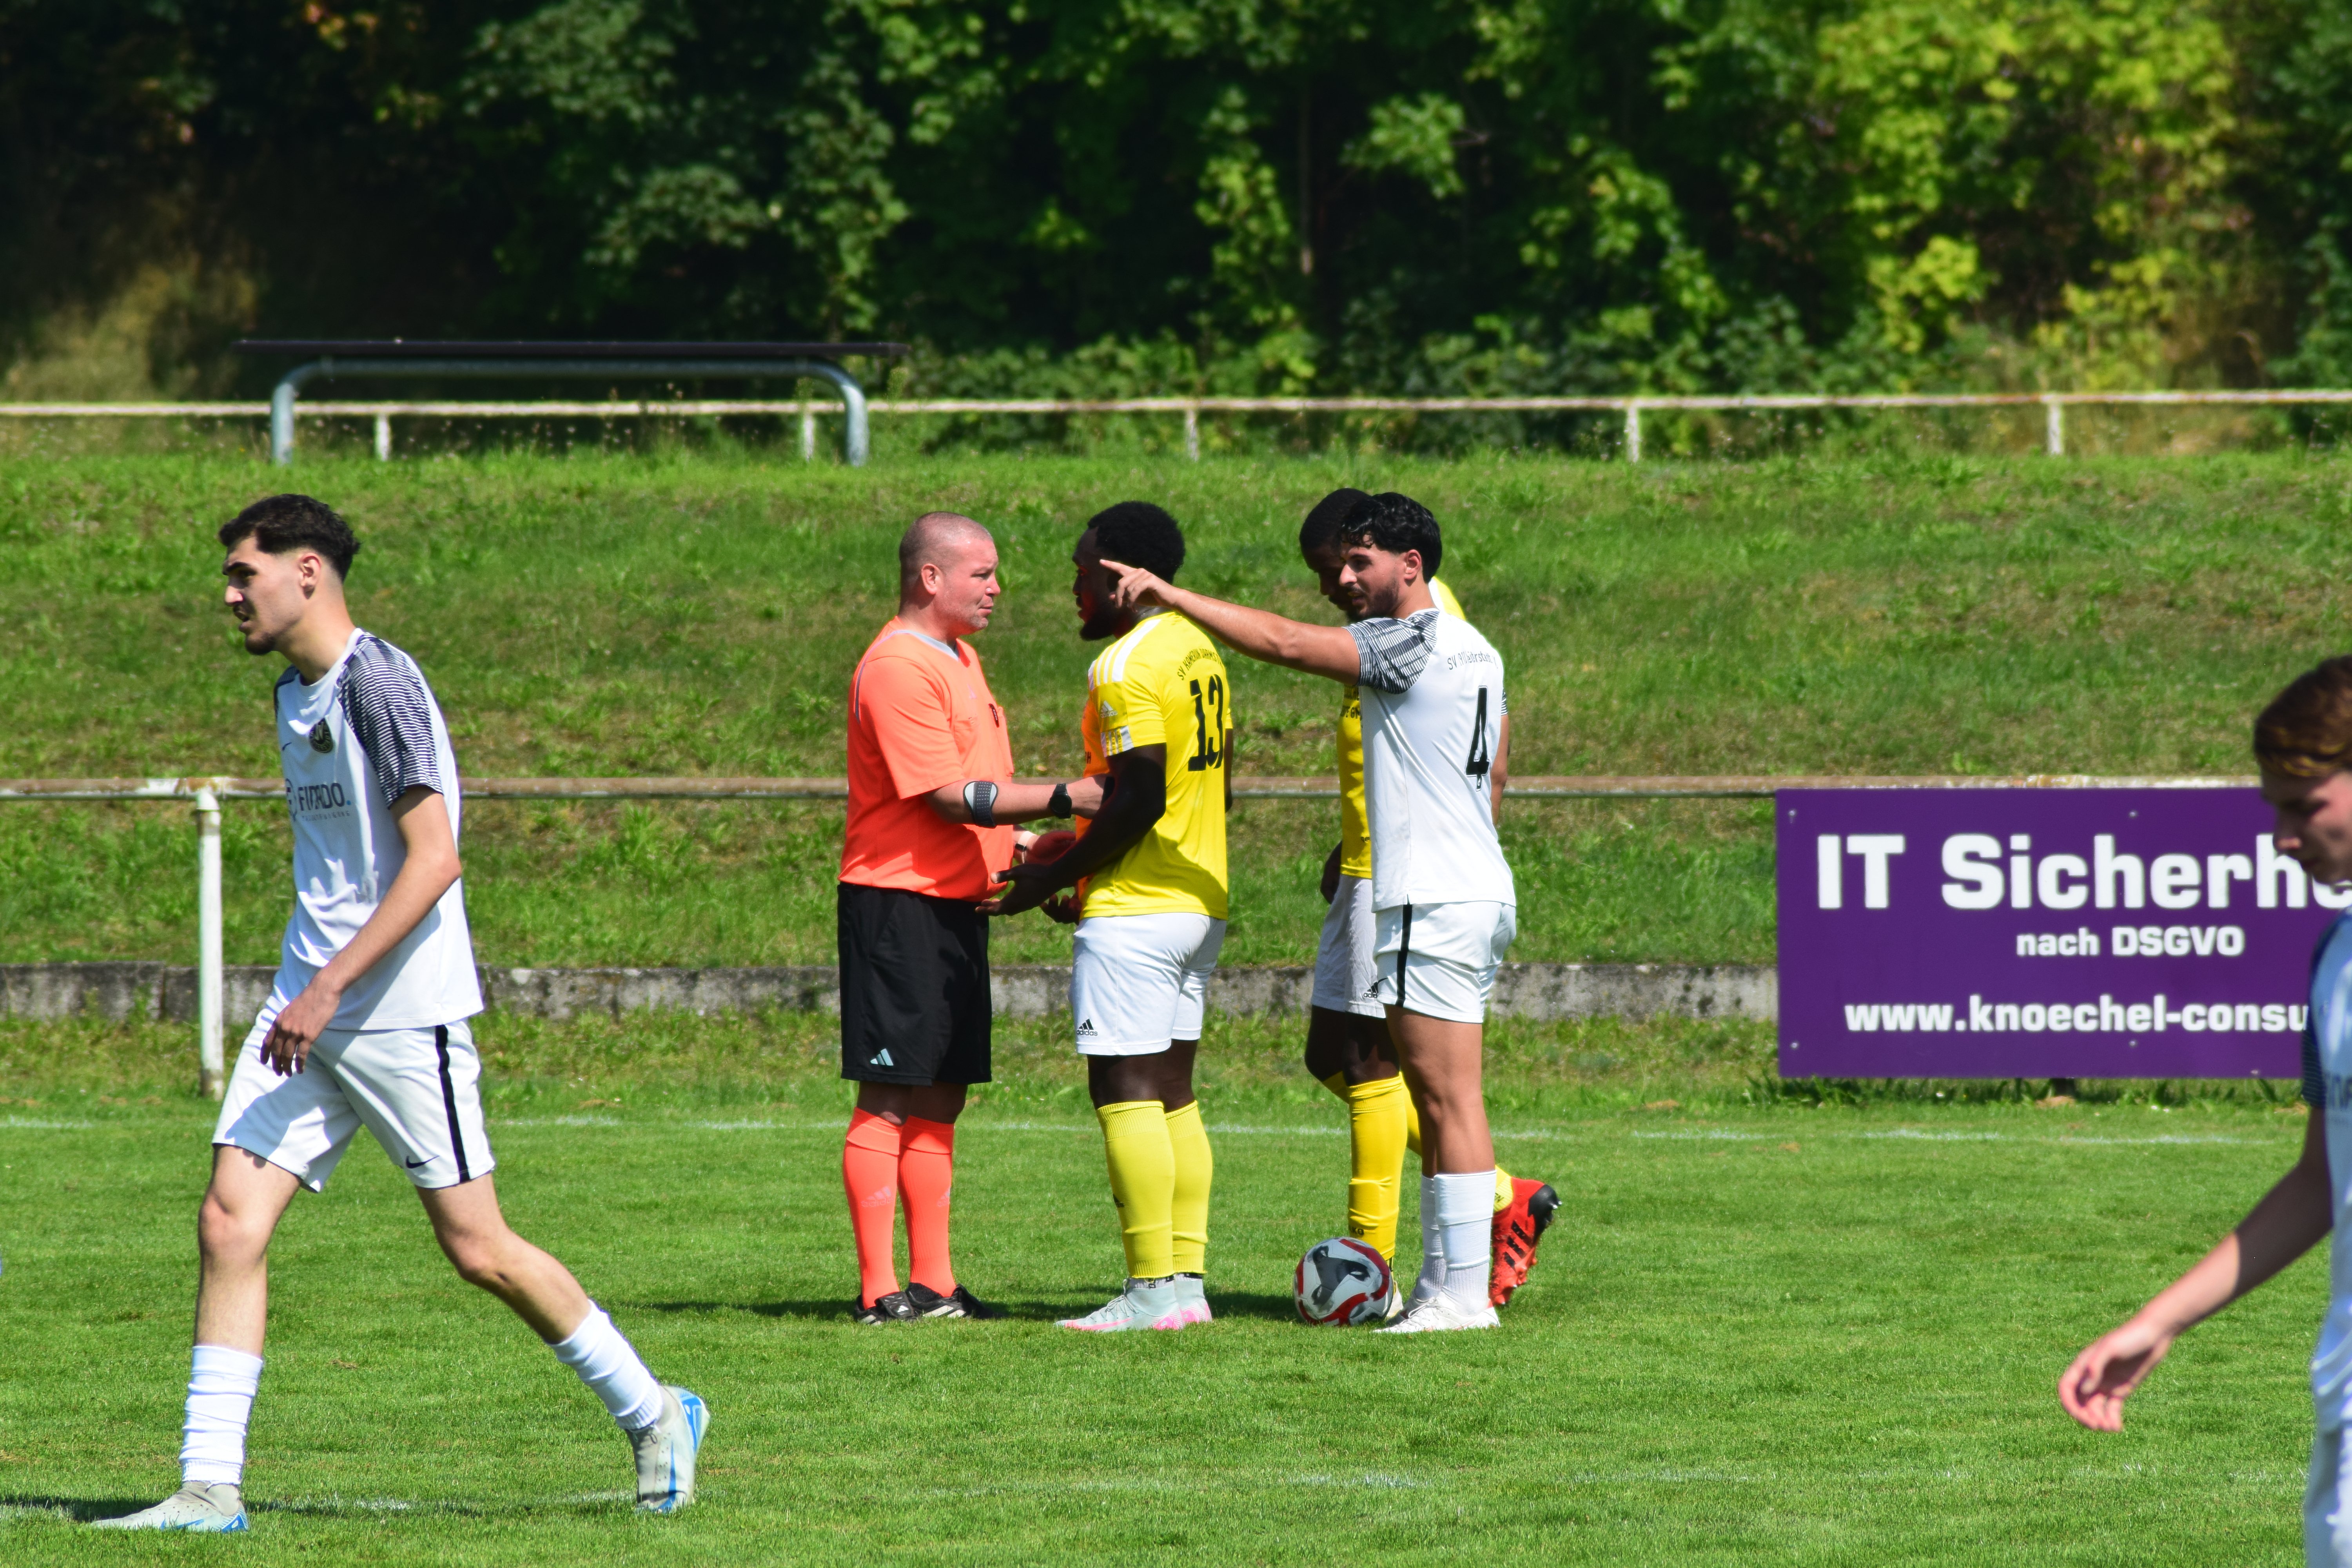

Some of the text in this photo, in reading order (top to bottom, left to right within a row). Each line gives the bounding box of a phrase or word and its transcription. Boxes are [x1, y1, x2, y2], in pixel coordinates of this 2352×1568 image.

[1177, 666, 1186, 681] SV
[1447, 655, 1457, 670] SV
[1188, 674, 1223, 771] 13
[1465, 686, 1490, 791] 4
[1818, 835, 1905, 909] IT
[2017, 926, 2245, 956] nach DSGVO
